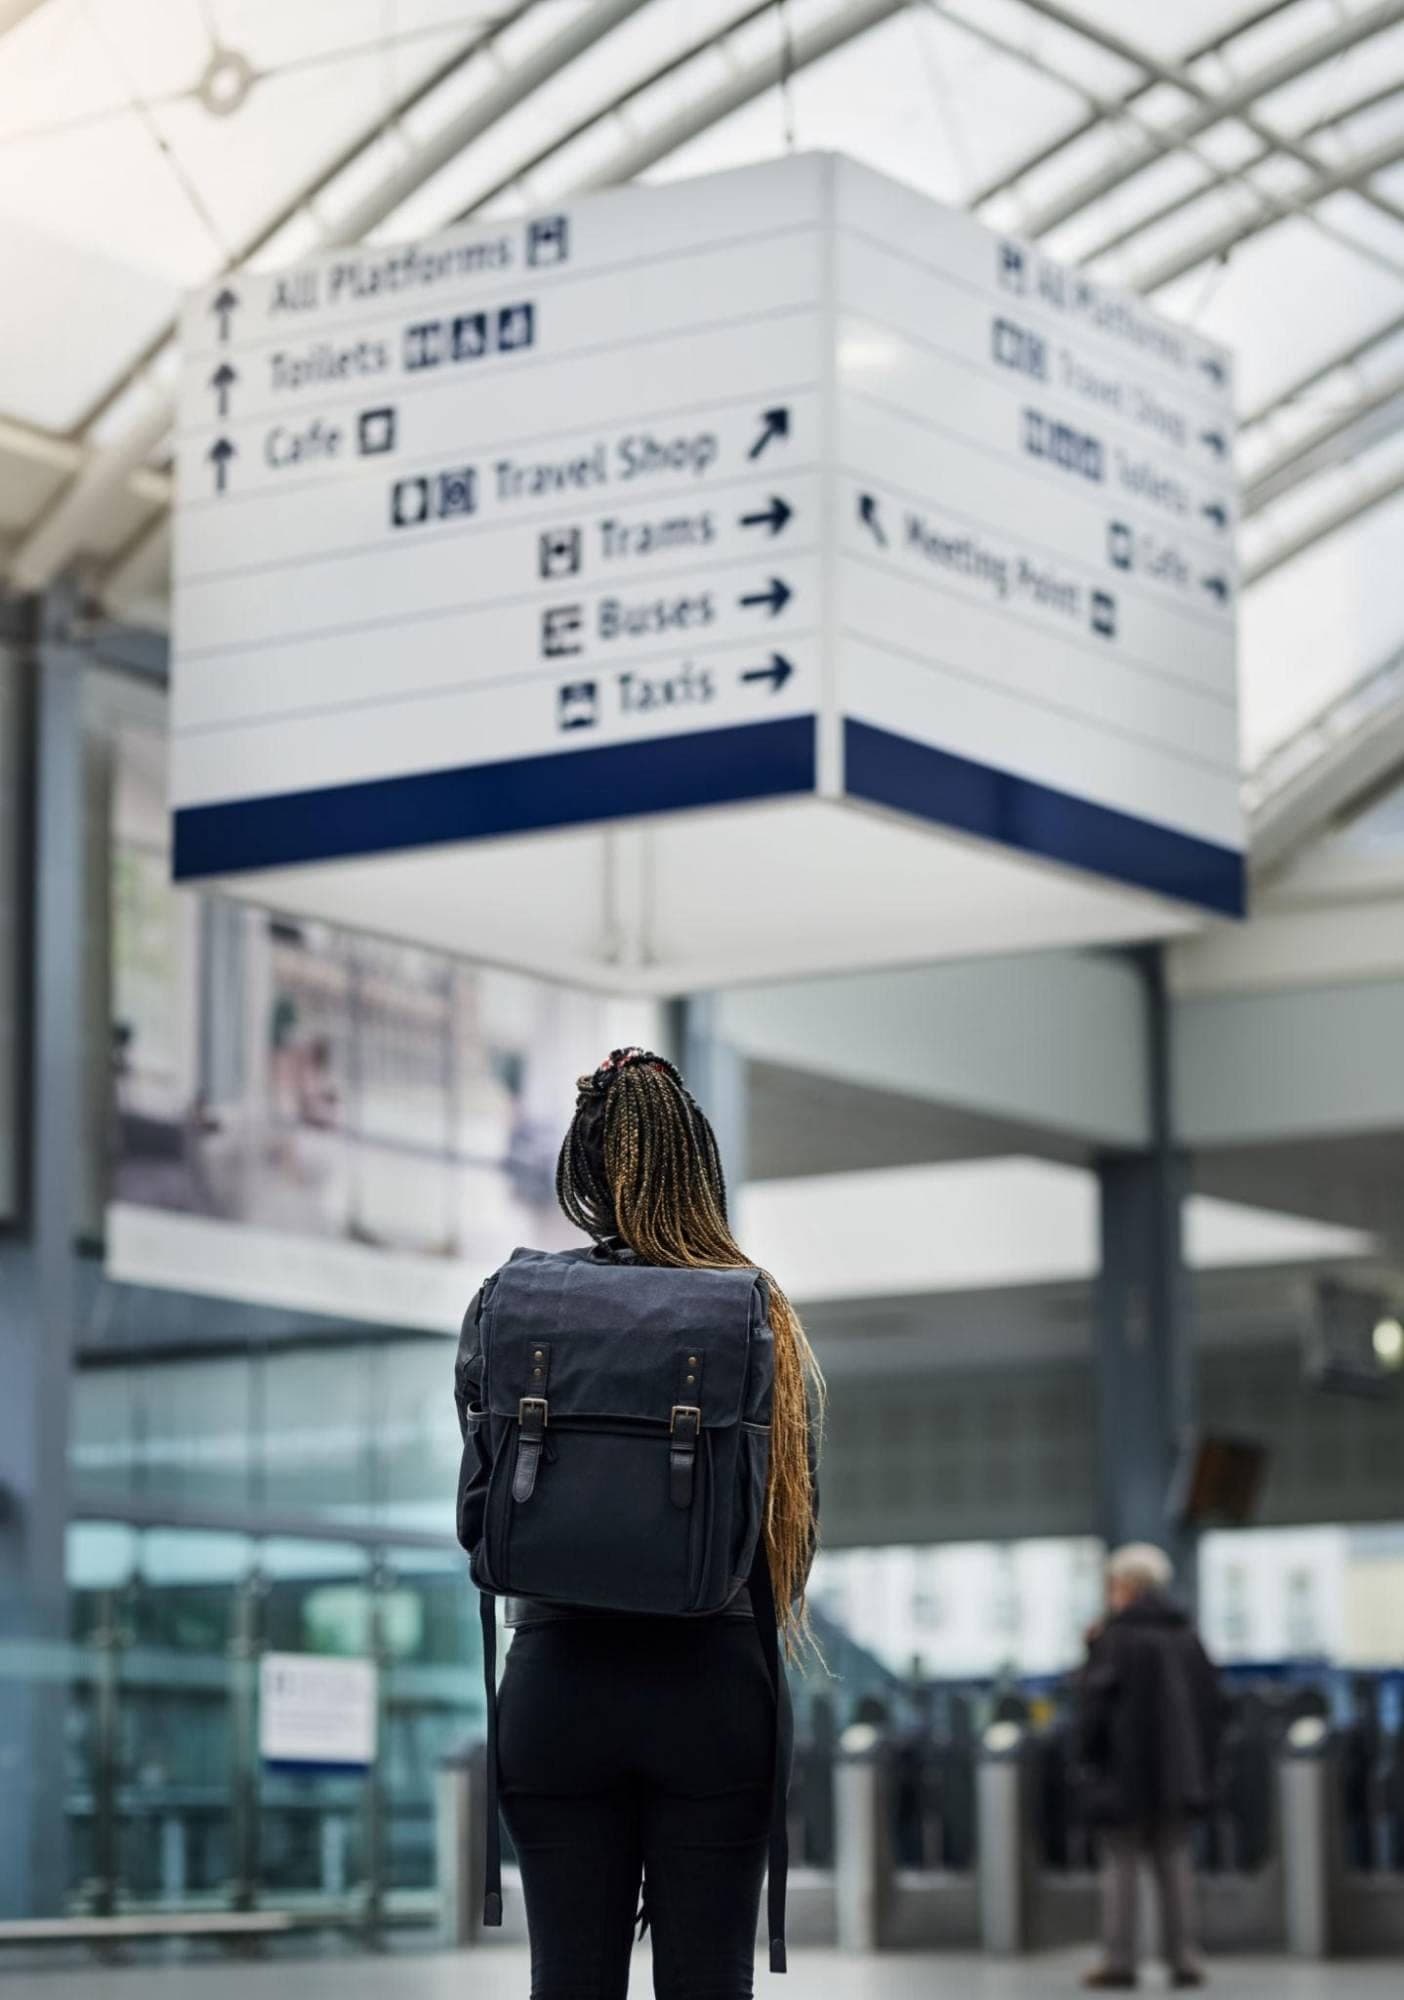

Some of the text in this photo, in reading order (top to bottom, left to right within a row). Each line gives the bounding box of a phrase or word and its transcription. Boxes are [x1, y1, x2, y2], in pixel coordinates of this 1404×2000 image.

[268, 239, 511, 314] All Platforms
[271, 340, 387, 389] Toilets
[265, 421, 341, 468] Cafe
[496, 433, 718, 501] Travel Shop
[599, 513, 716, 559] Trams
[598, 594, 716, 639] Buses
[619, 664, 715, 711] Taxis
